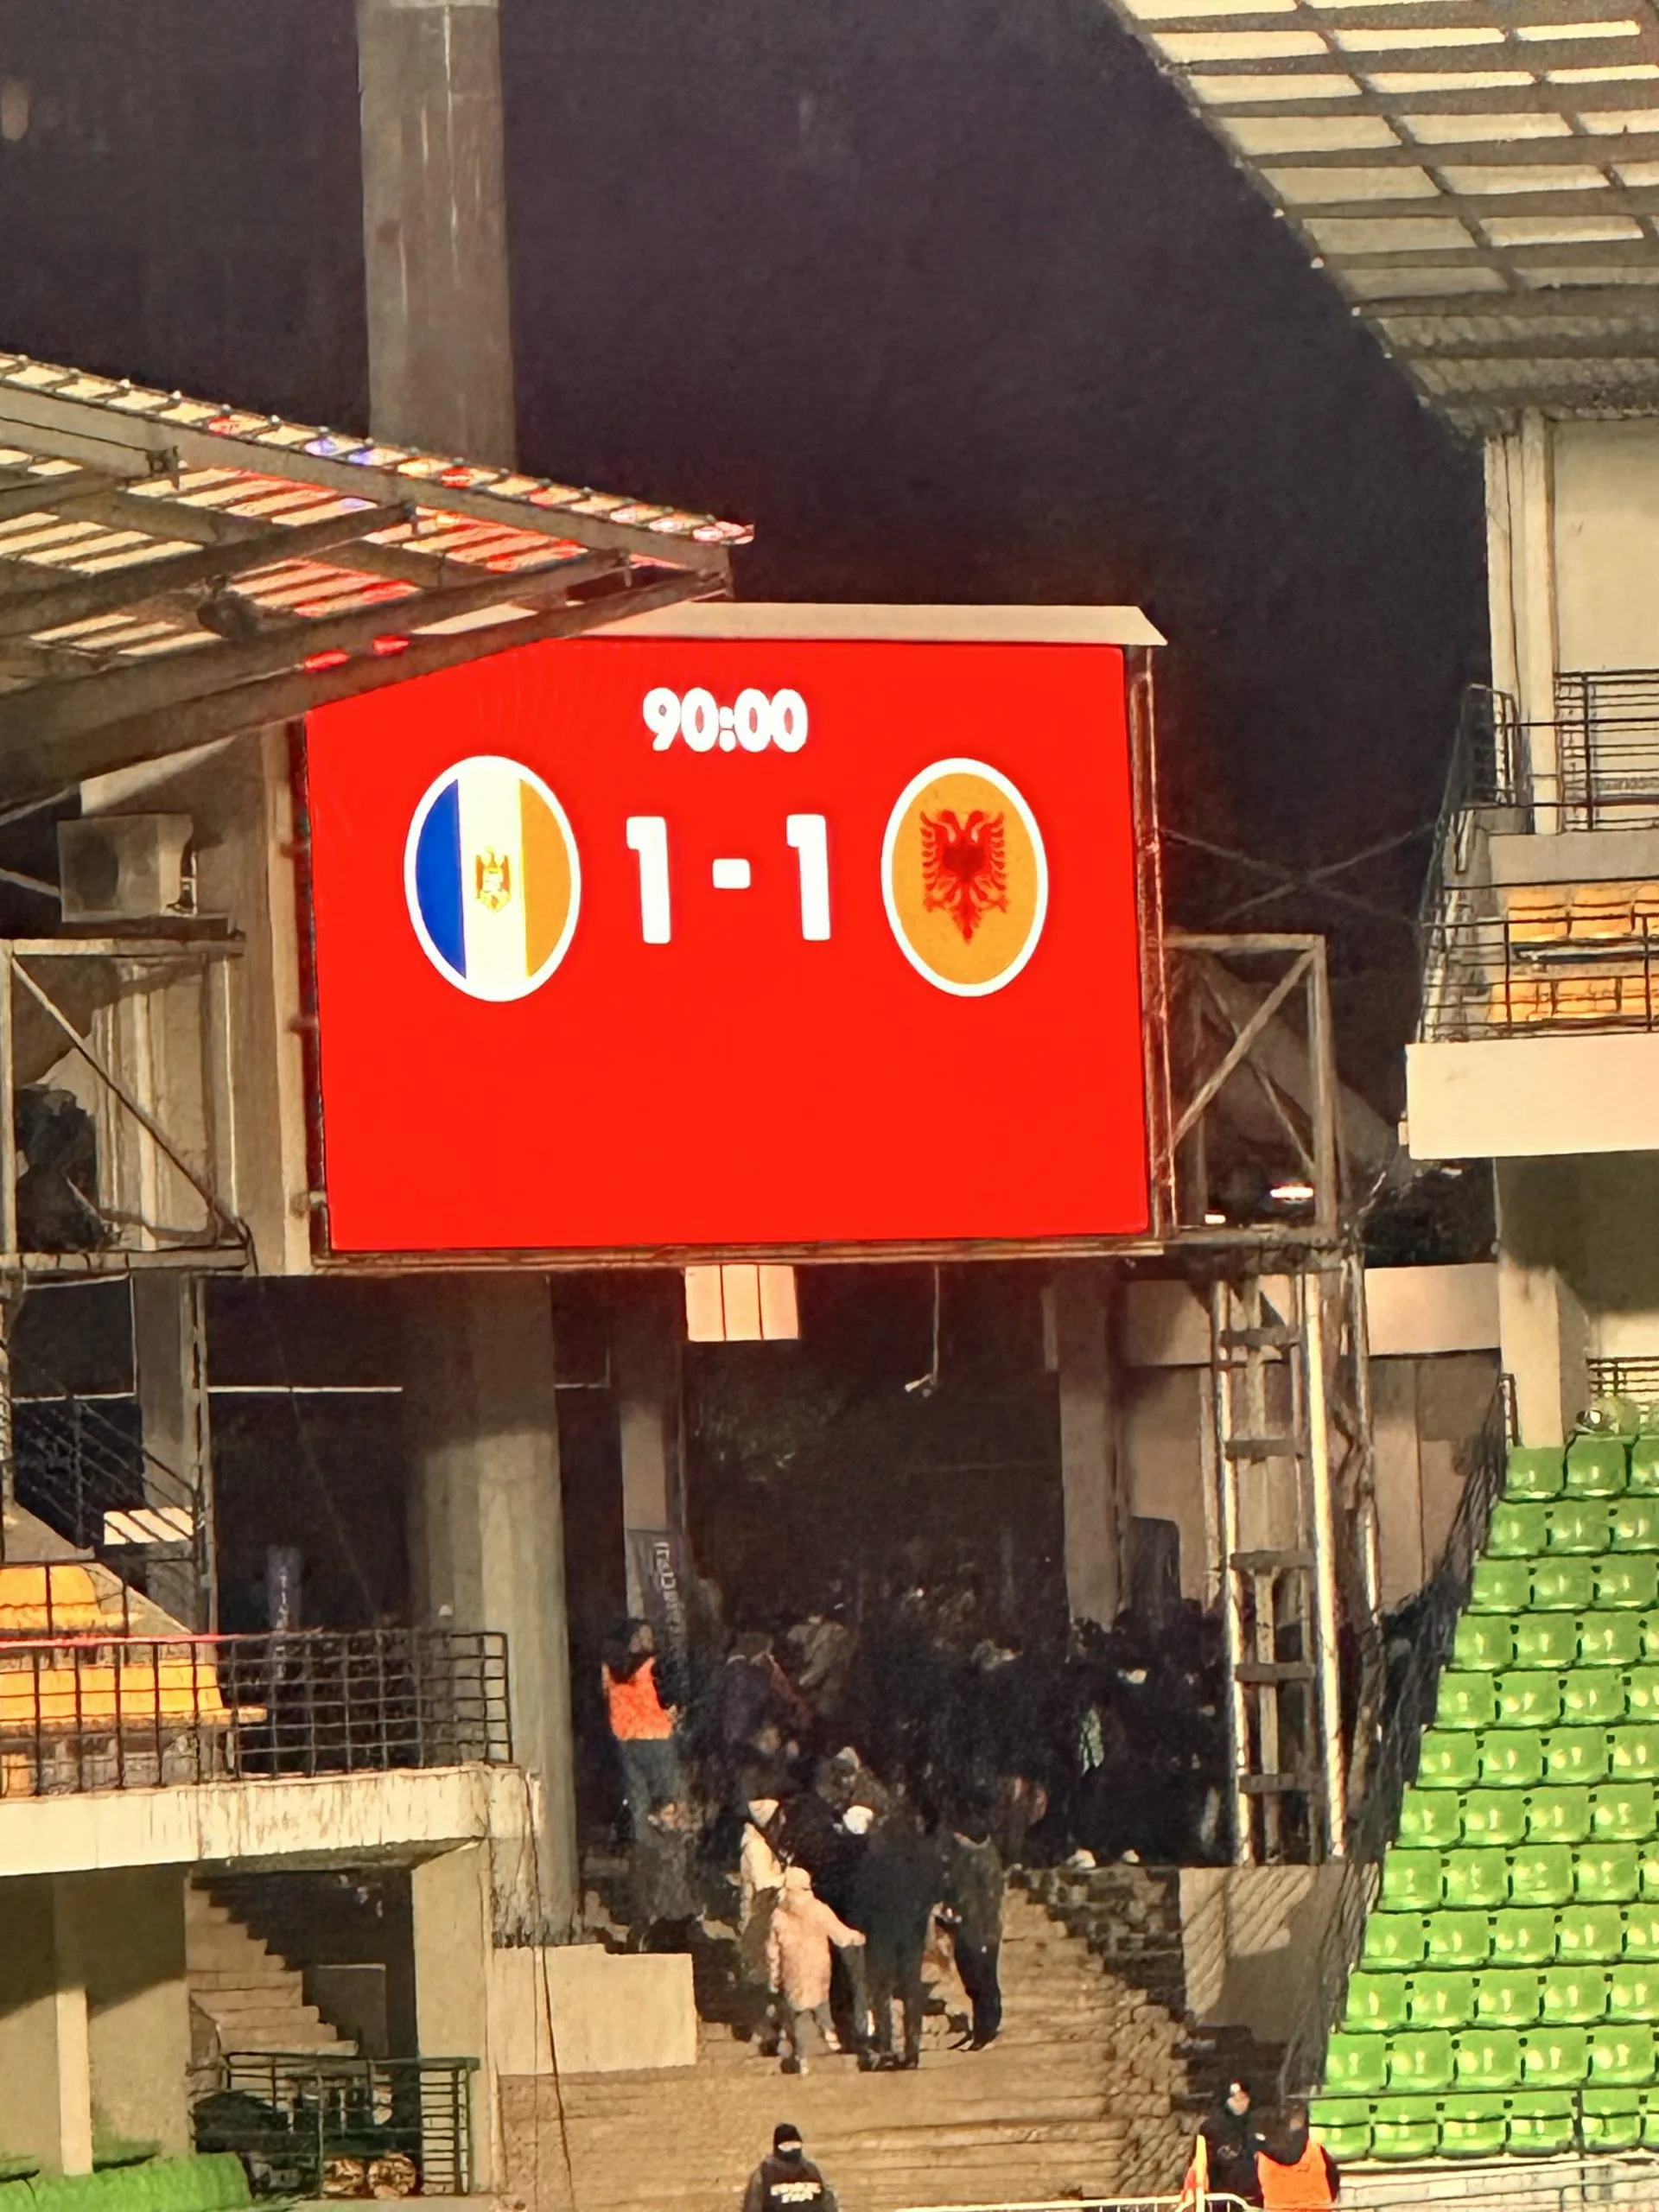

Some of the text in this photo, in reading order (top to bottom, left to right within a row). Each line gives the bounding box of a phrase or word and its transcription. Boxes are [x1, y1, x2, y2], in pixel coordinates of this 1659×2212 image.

[643, 687, 809, 753] 90:00
[626, 816, 671, 944] 1
[786, 814, 830, 941] 1
